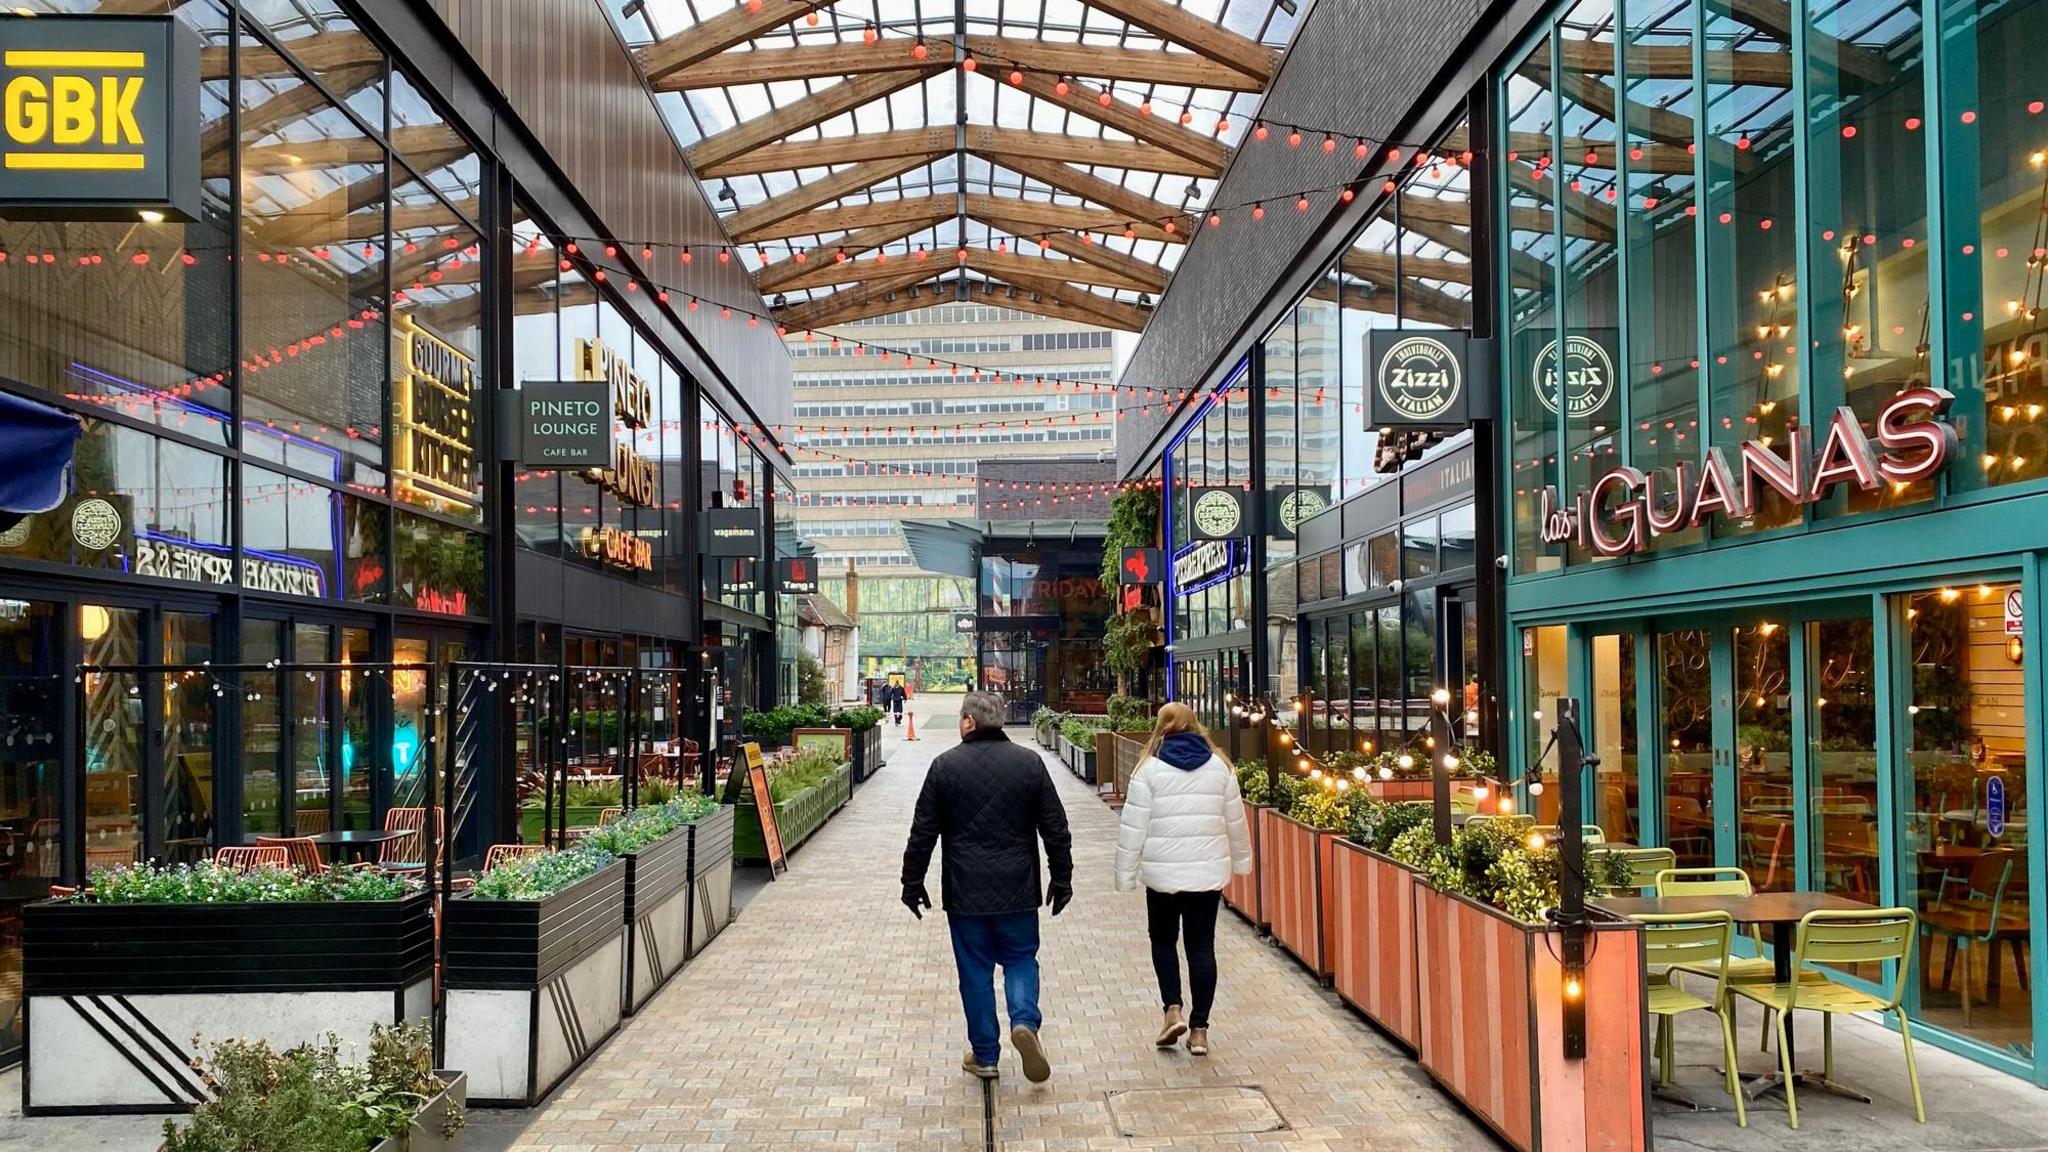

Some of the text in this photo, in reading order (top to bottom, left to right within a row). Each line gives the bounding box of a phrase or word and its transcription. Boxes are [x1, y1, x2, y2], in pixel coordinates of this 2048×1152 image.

[5, 76, 145, 144] GBK
[1395, 344, 1445, 362] INDIVIDUALLY
[1390, 368, 1449, 388] Zizzi
[530, 401, 600, 416] PINETO
[1396, 394, 1445, 413] ITALIAN
[533, 423, 598, 435] LOUNGE
[570, 448, 588, 456] BAR
[1539, 386, 1958, 558] las IGUANAS
[714, 529, 755, 538] wagamama
[635, 537, 653, 571] BAR
